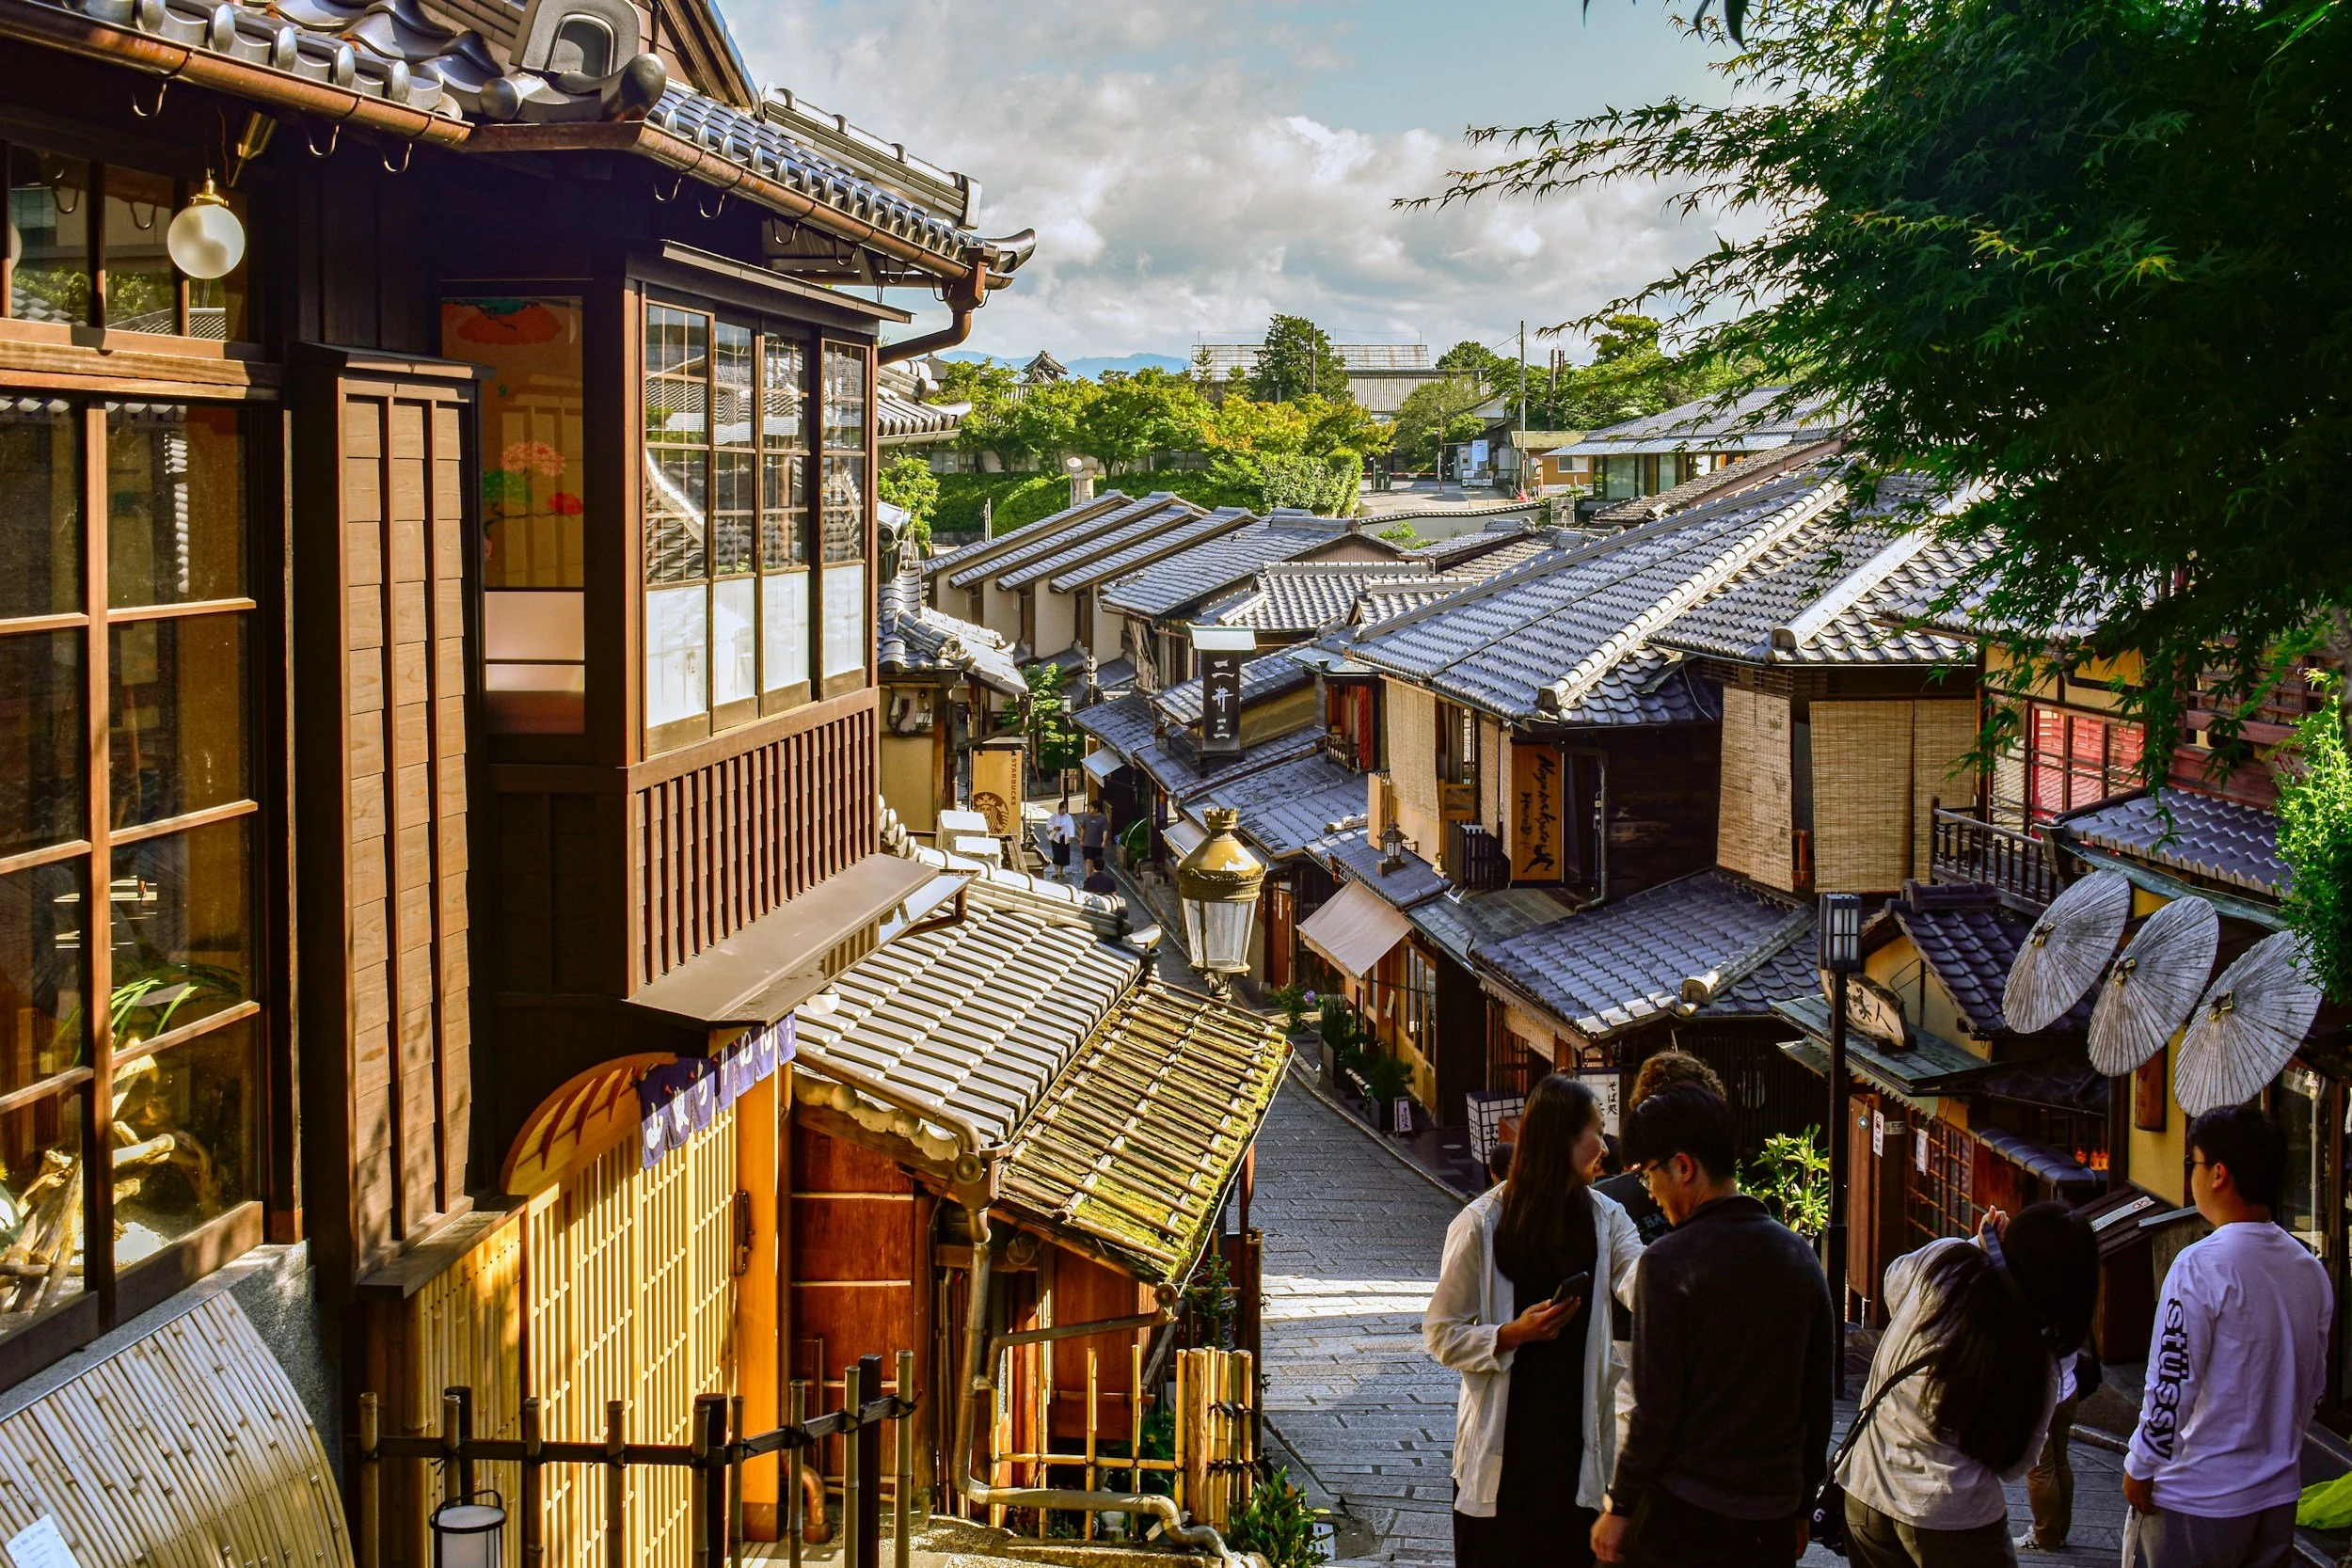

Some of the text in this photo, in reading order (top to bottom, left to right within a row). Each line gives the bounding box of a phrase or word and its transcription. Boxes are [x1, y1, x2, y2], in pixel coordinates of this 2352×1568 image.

[1608, 1081, 1618, 1115] そば処
[1812, 1508, 1826, 1523] 6
